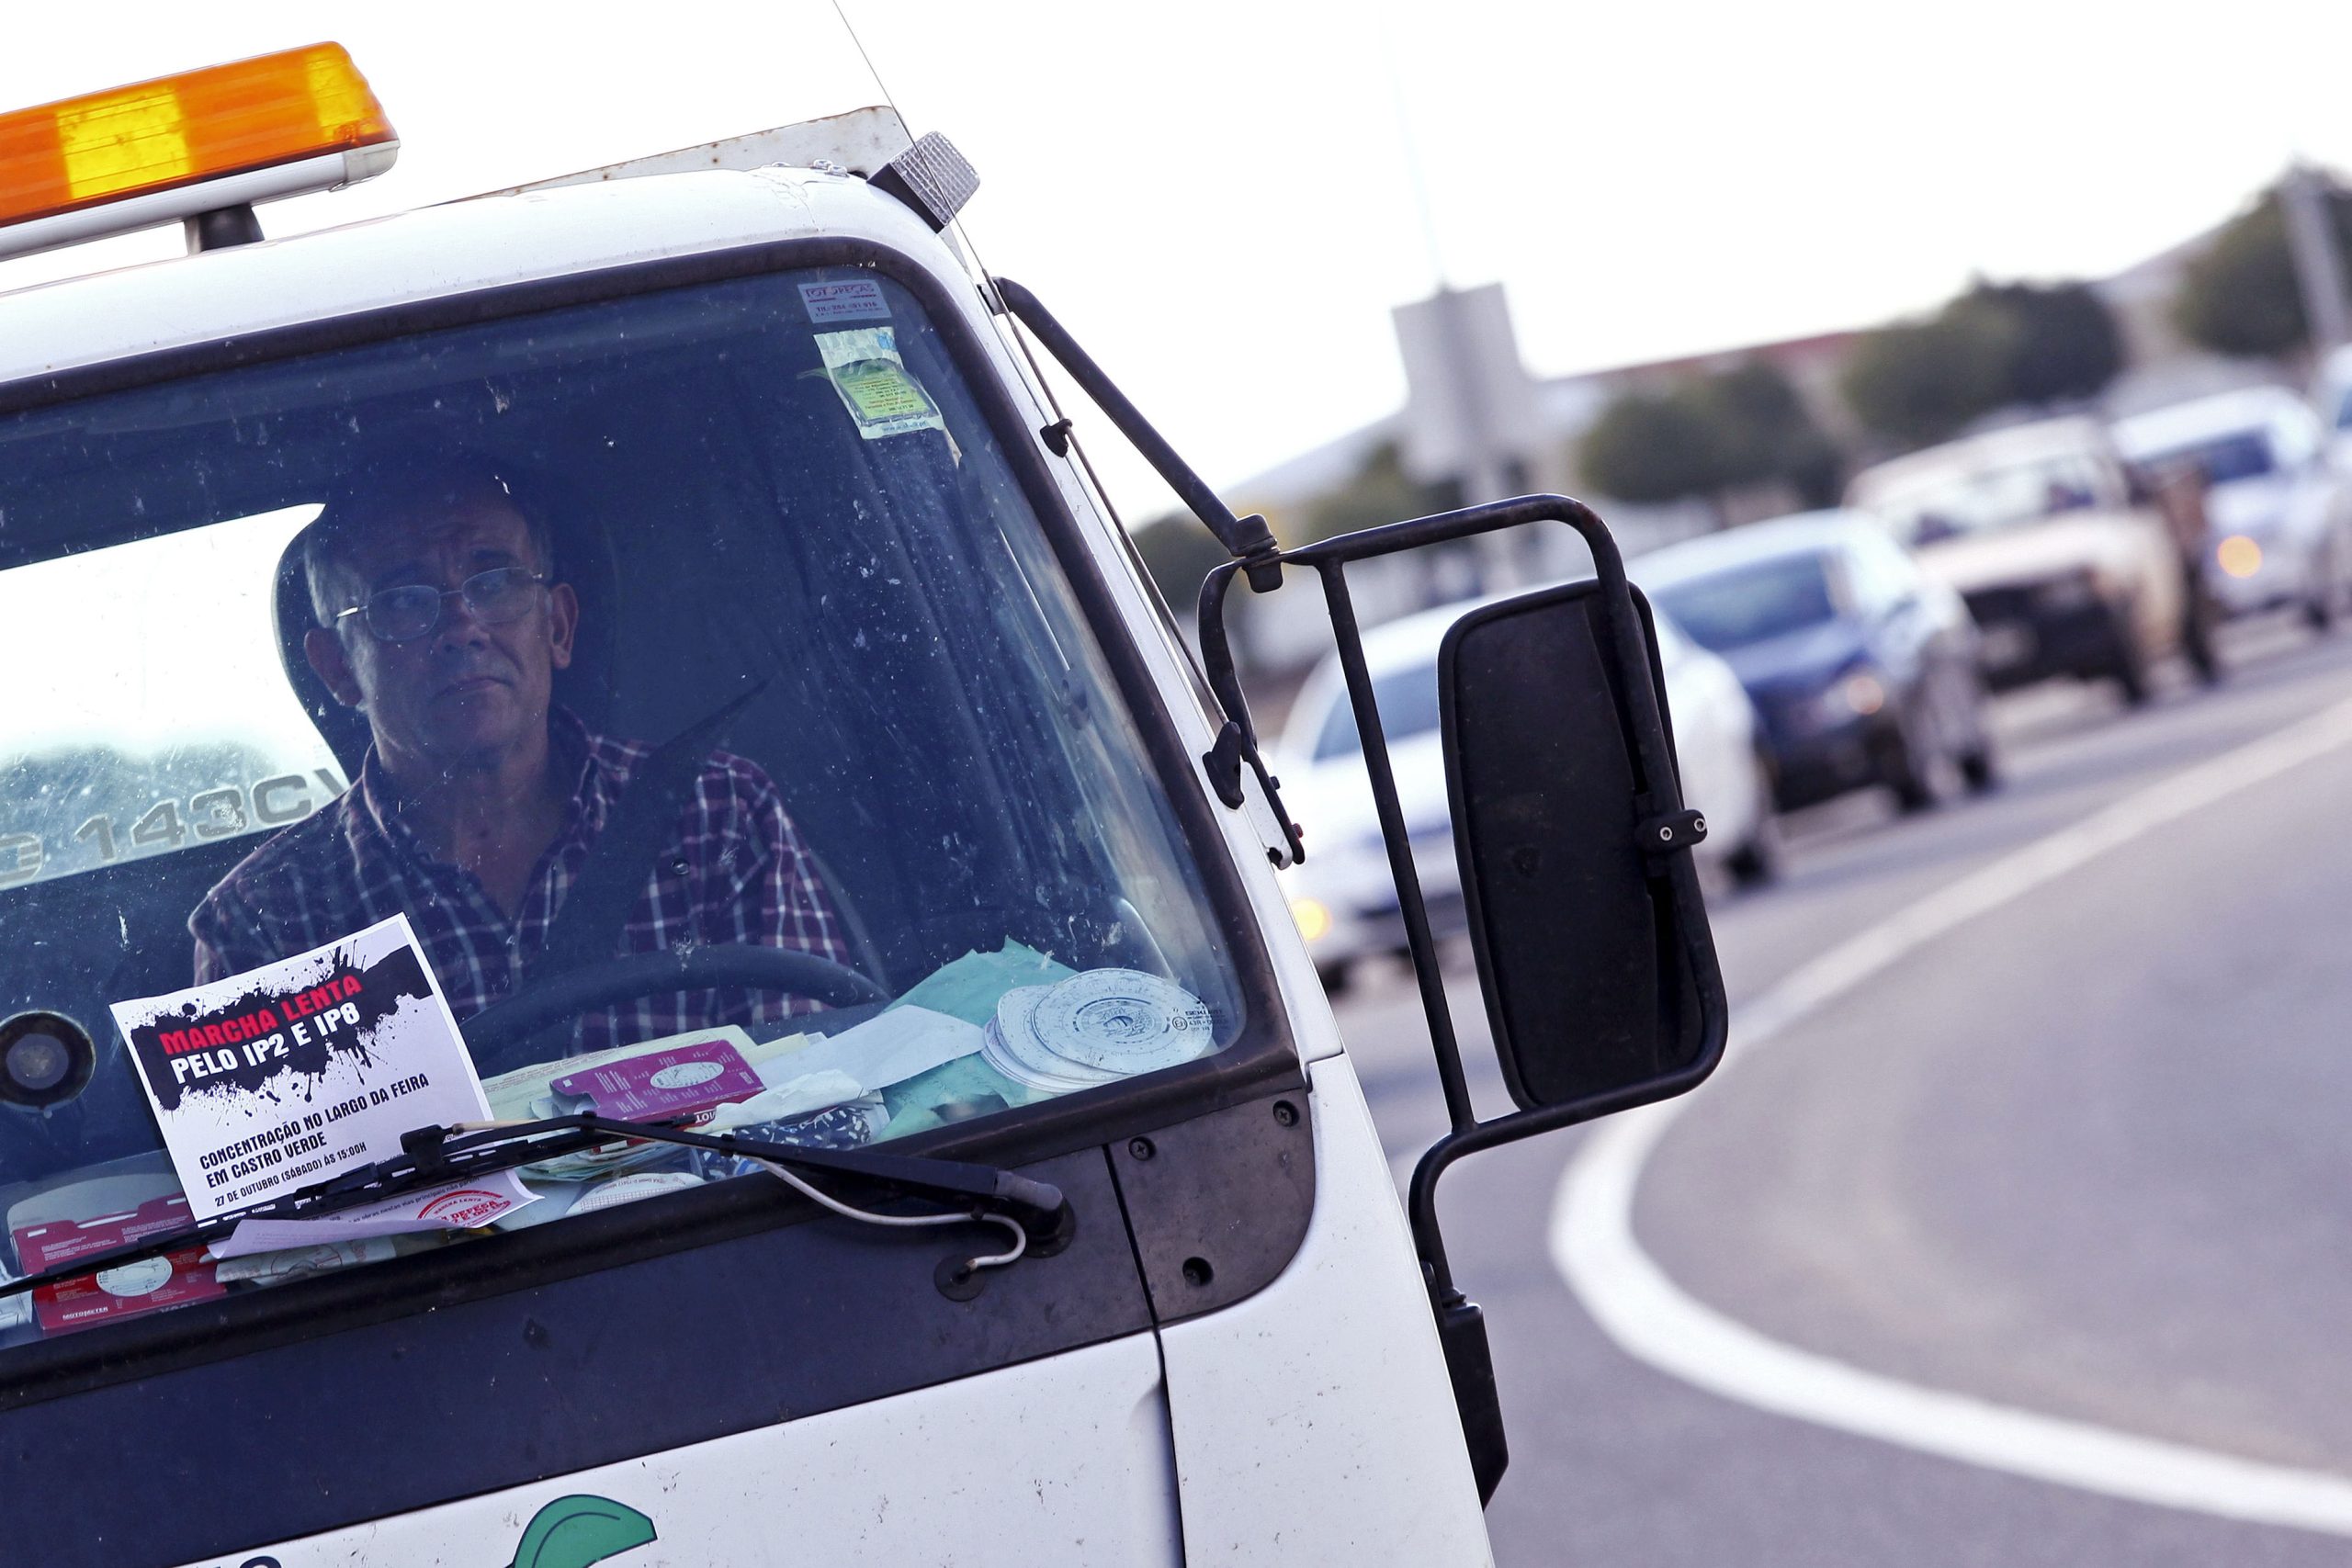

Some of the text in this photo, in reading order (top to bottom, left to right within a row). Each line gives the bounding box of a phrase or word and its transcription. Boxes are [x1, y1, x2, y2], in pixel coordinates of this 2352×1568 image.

[159, 975, 363, 1055] MARCHA LENTA
[170, 1002, 360, 1084] PELO IP2 E IP8
[199, 1073, 429, 1169] CONCENTRAÇÃO NO LARGO DA FEIRA
[206, 1132, 328, 1189] EM CASTRO VERDE
[215, 1195, 225, 1207] 27
[227, 1190, 239, 1204] DE
[240, 1174, 279, 1198] OUTUBRO
[280, 1158, 323, 1182] (SÁBADO)
[323, 1153, 337, 1167] ÀS
[337, 1142, 368, 1162] 15:00H
